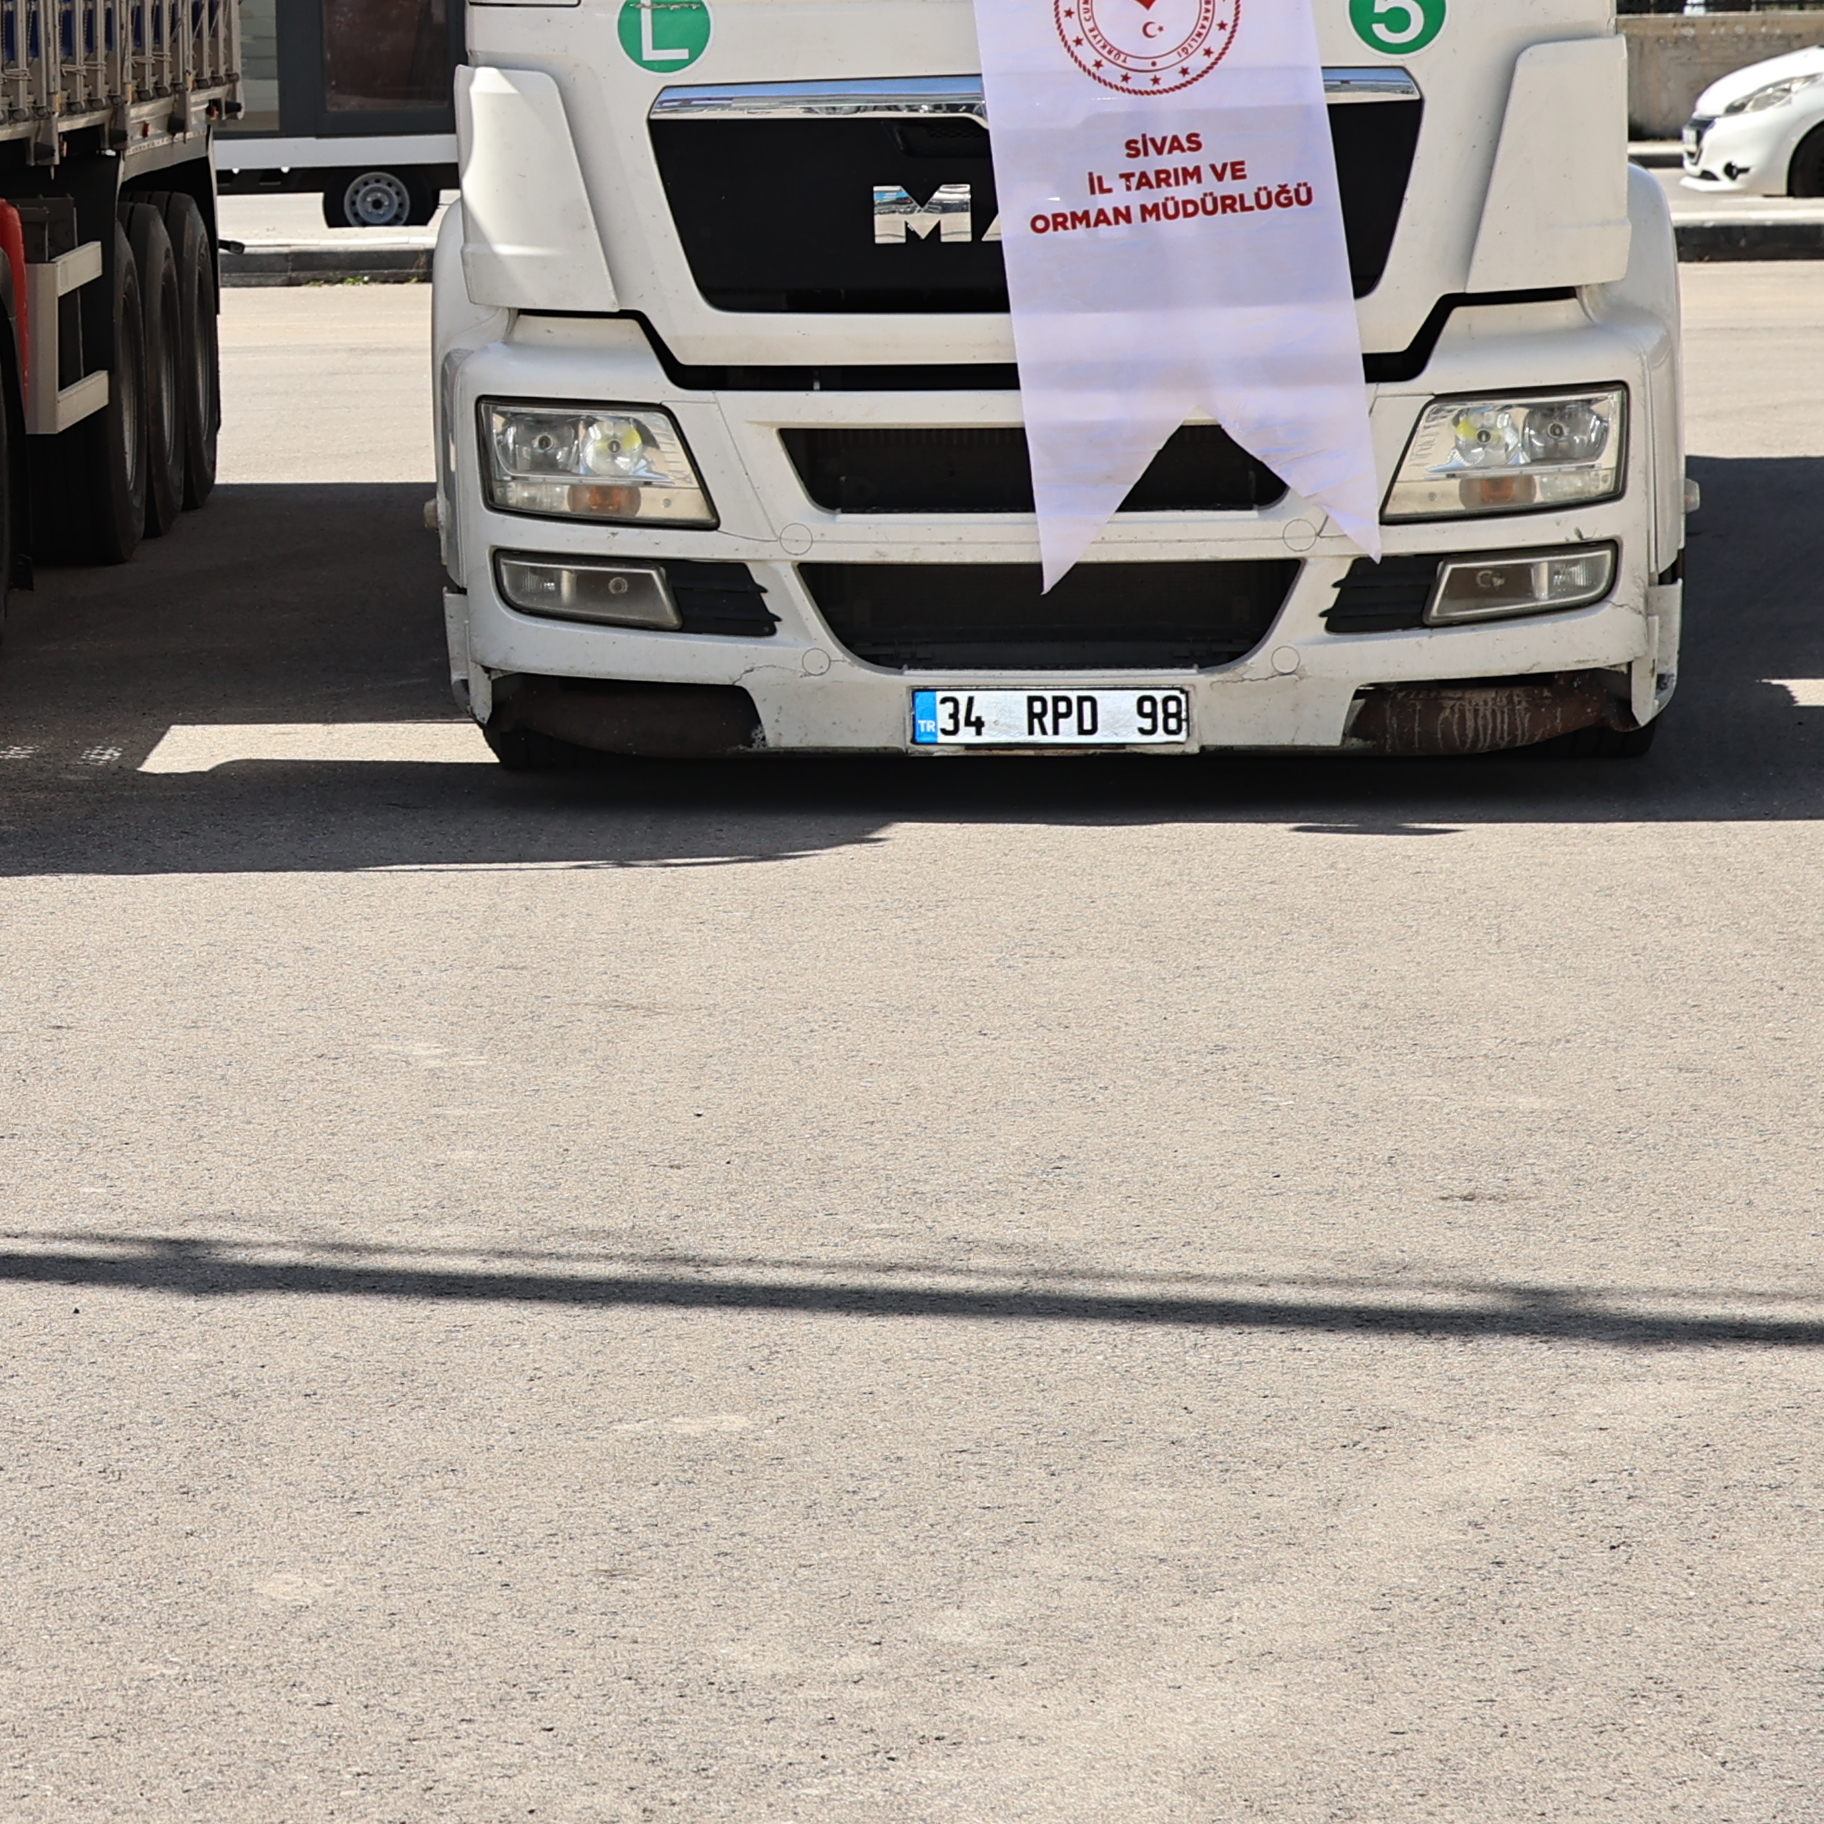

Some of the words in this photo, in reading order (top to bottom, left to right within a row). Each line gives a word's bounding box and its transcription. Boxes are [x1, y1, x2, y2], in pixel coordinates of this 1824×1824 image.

[1088, 26, 1128, 63] TÜRKİYE
[1177, 0, 1212, 58] BAKANLIĞI
[1125, 132, 1203, 158] SİVAS
[1088, 171, 1113, 195] İL
[1118, 165, 1203, 191] TARIM
[1210, 160, 1247, 183] VE
[1030, 205, 1133, 234] ORMAN
[1140, 182, 1313, 223] MÜDÜRLÜĞÜ
[918, 720, 936, 732] TR
[939, 695, 985, 736] 34
[1027, 695, 1098, 736] RPD
[1137, 695, 1183, 736] 98
